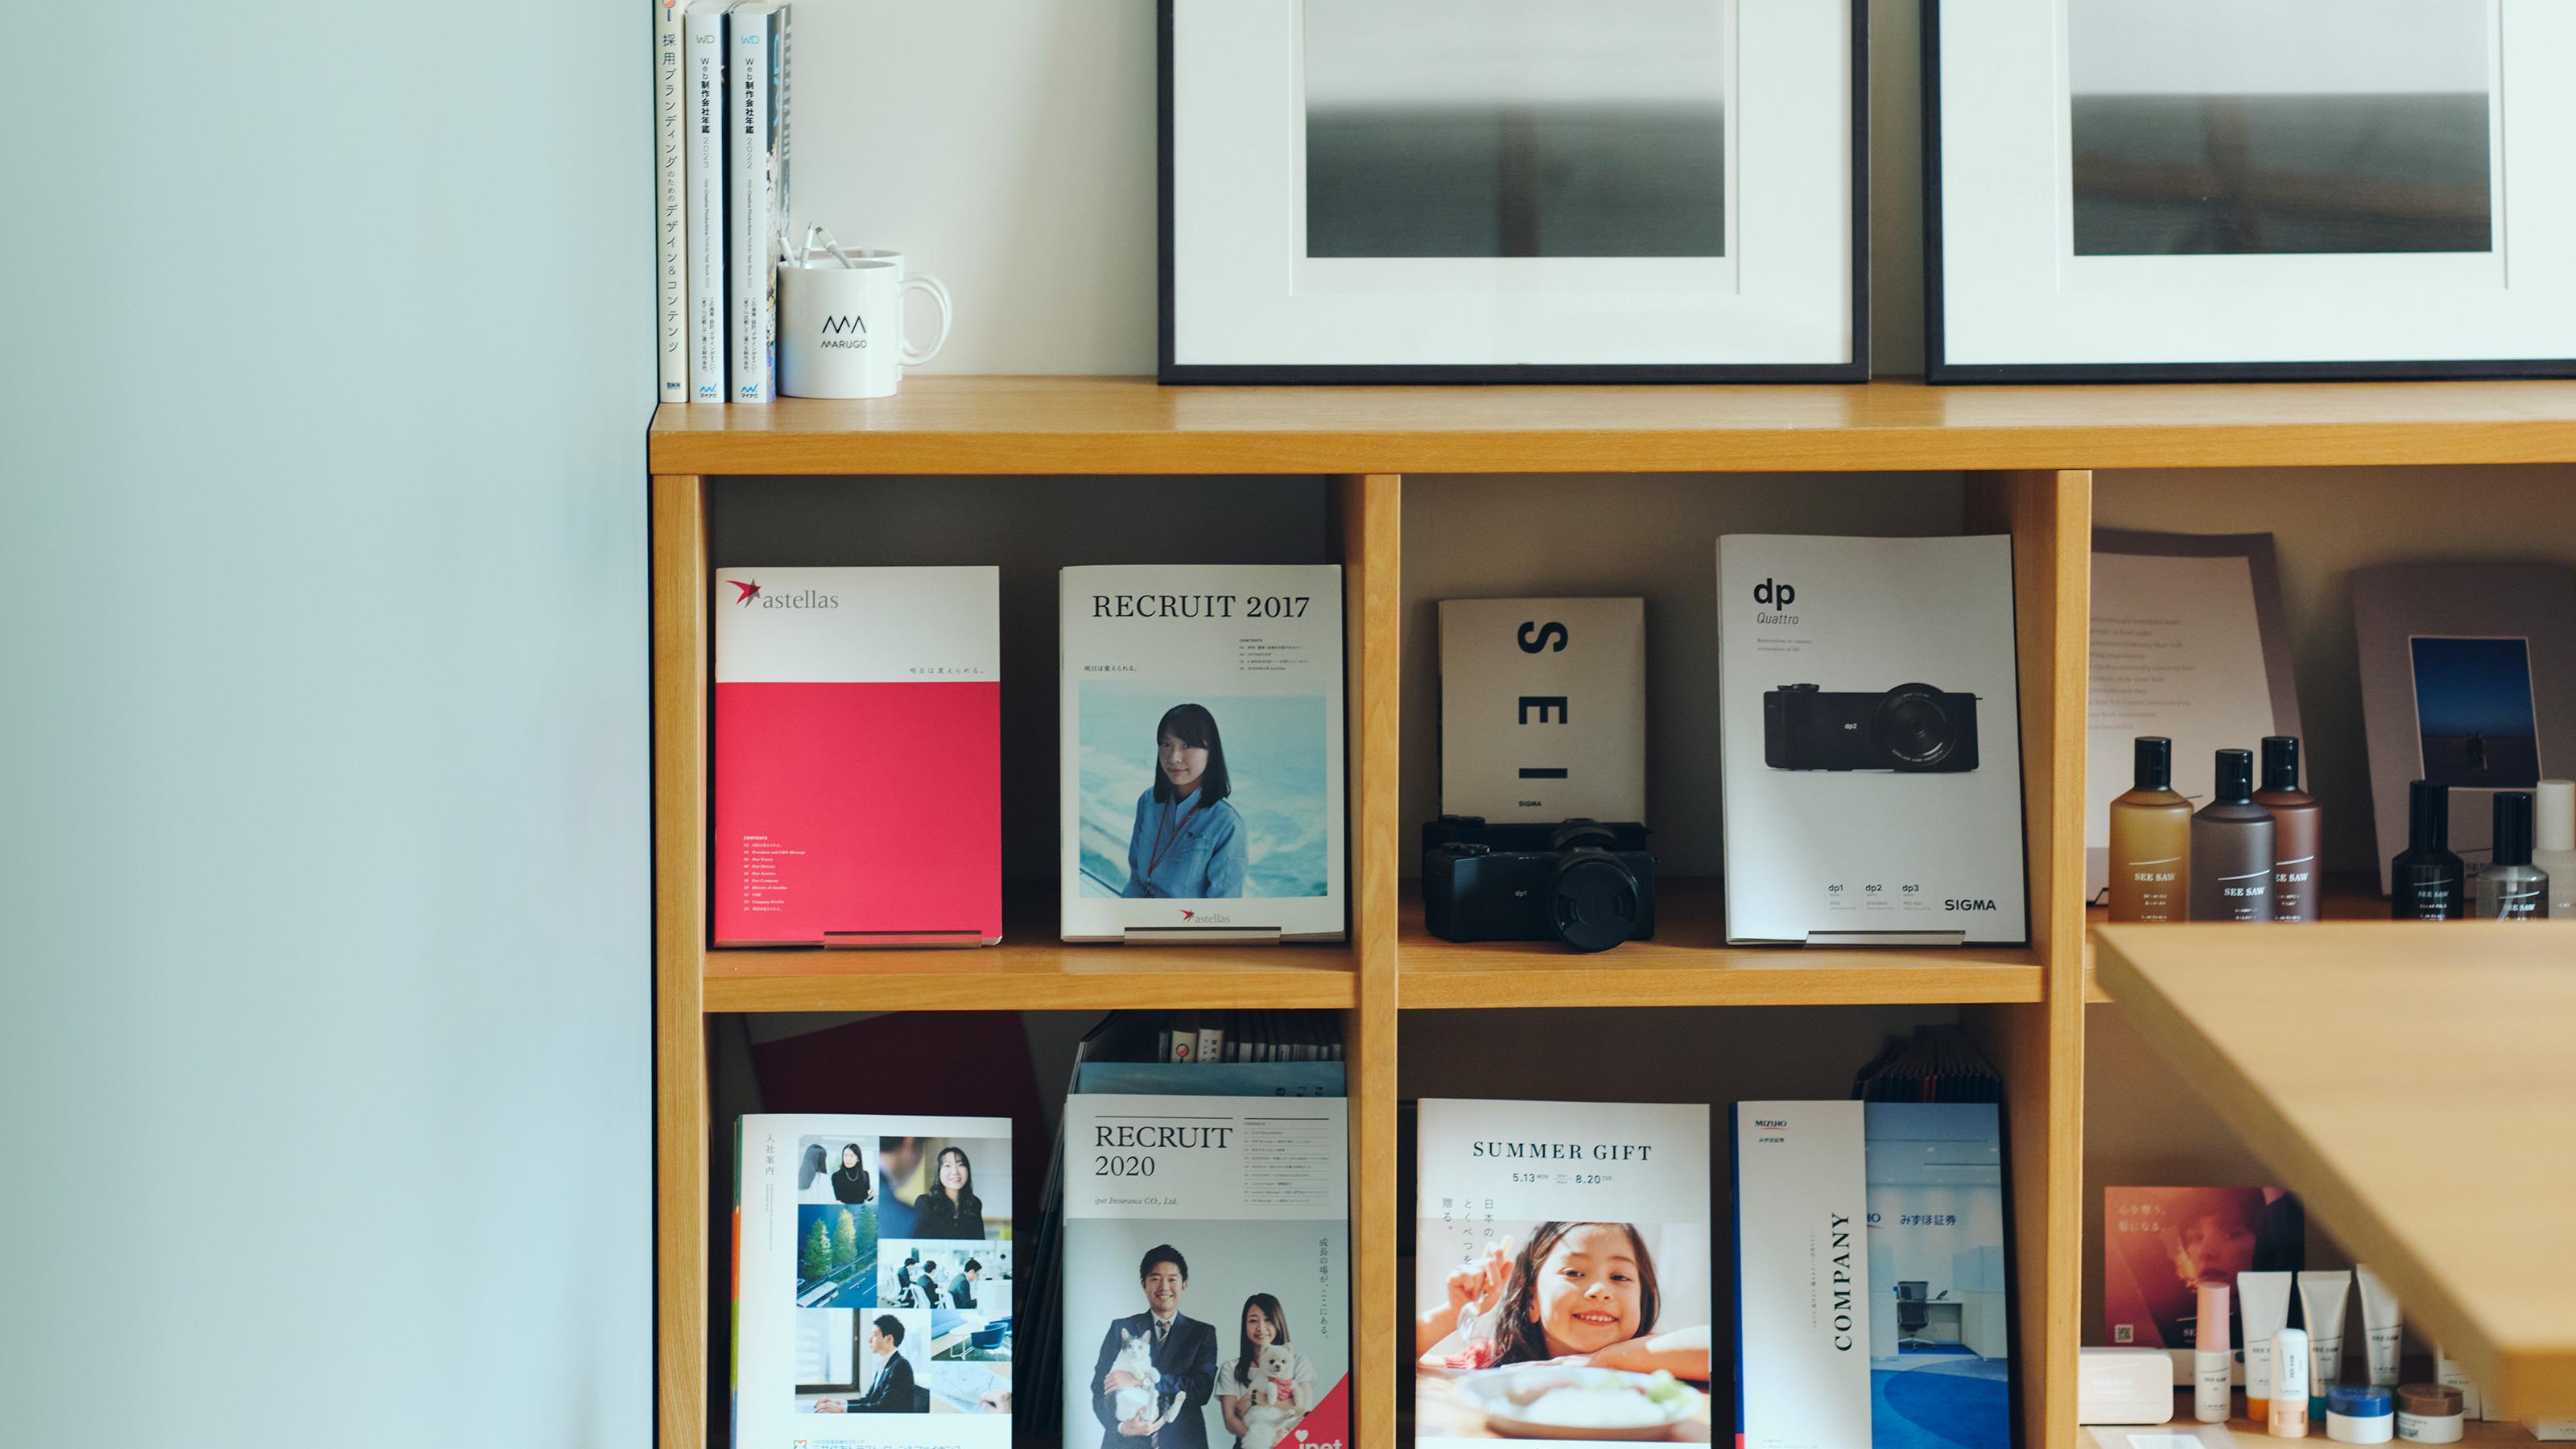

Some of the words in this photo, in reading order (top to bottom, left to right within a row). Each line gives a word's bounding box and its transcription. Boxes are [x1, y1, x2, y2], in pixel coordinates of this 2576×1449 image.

[820, 341, 868, 349] MARUGO
[762, 590, 839, 609] astellas
[1753, 578, 1795, 611] dp
[1092, 595, 1236, 617] RECRUIT
[1246, 597, 1310, 617] 2017
[1757, 612, 1799, 625] Quattro
[2134, 873, 2154, 881] SEE
[2155, 873, 2176, 882] SAW
[2289, 873, 2309, 882] SAW
[1515, 890, 1527, 898] dp1
[1828, 884, 1843, 893] dp1
[1865, 884, 1883, 893] dp2
[1902, 884, 1920, 893] dp3
[2224, 888, 2244, 896] SEE
[2246, 886, 2265, 896] SAW
[1944, 899, 1997, 911] SIGMA
[1195, 914, 1231, 923] astellas
[1095, 1125, 1233, 1149] RECRUIT
[766, 1133, 775, 1176] 入社案内
[1473, 1141, 1583, 1160] SUMMER
[1593, 1145, 1652, 1161] GIFT
[1095, 1155, 1155, 1177] 2020
[1513, 1173, 1535, 1183] 5.13
[1575, 1174, 1601, 1184] 8.20
[1443, 1197, 1453, 1231] 贈る。
[1484, 1199, 1494, 1238] 日本の
[1900, 1214, 1956, 1226] みずほ証券
[1463, 1198, 1473, 1265] とくべつを
[1831, 1212, 1852, 1352] COMPANY
